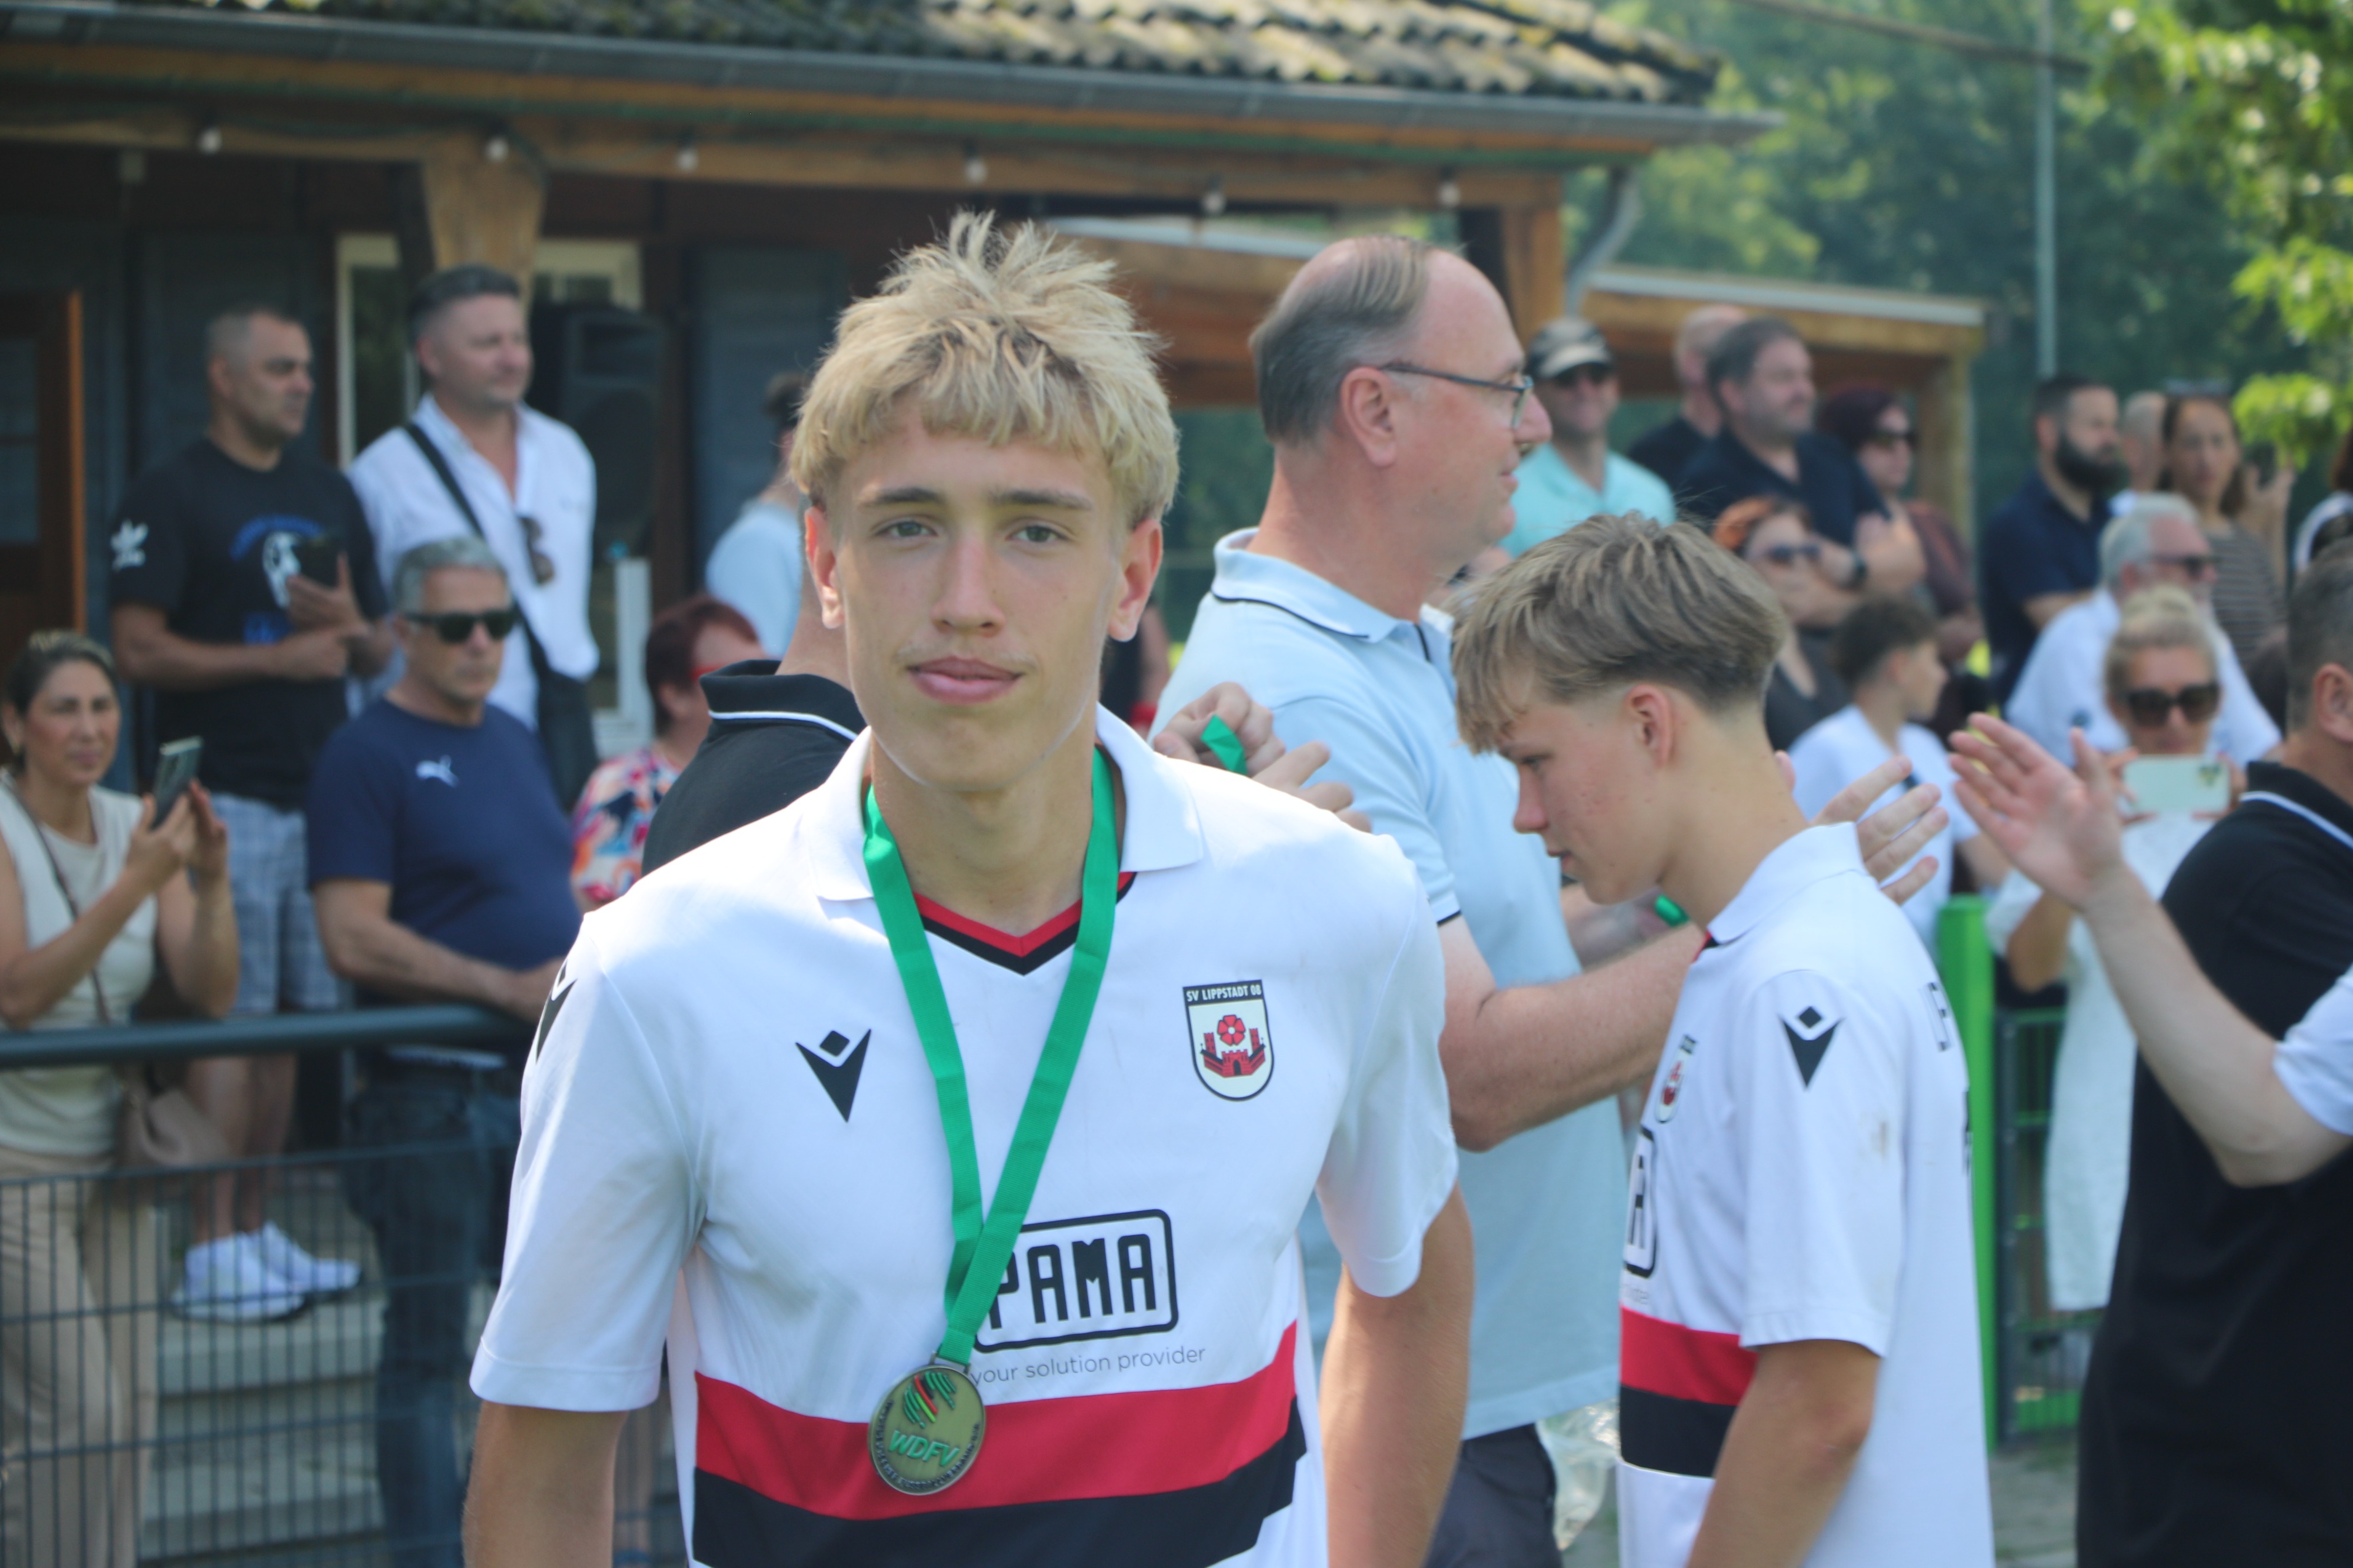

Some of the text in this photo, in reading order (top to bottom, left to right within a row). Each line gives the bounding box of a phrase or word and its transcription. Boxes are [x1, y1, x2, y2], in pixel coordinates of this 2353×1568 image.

[1186, 984, 1262, 1002] SV LIPPSTADT 08
[988, 1233, 1156, 1329] PAMA
[970, 1345, 1206, 1387] your solution provider
[888, 1430, 961, 1467] WDFV
